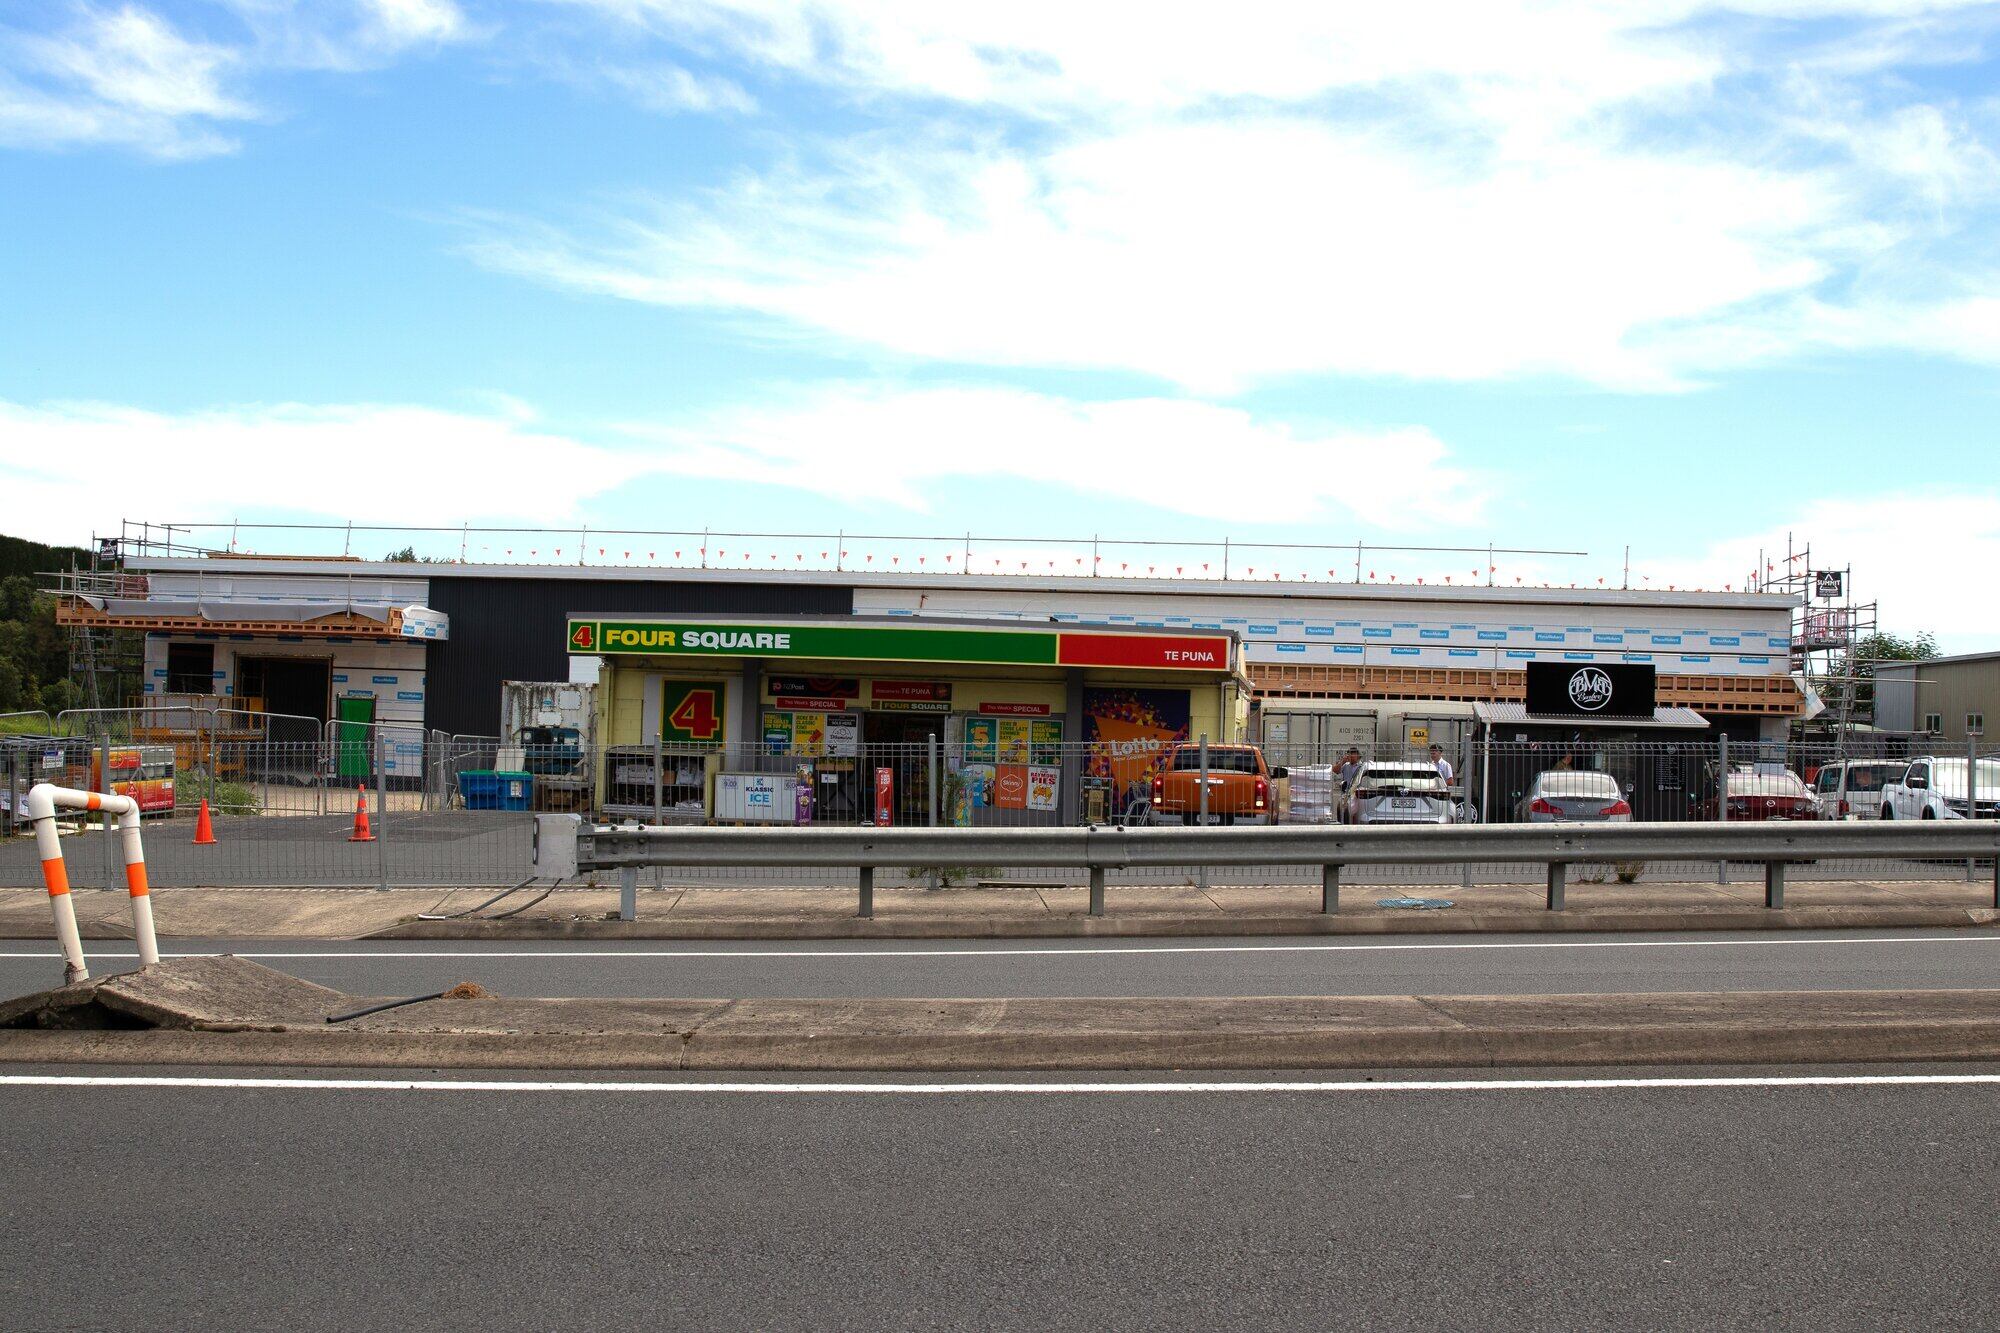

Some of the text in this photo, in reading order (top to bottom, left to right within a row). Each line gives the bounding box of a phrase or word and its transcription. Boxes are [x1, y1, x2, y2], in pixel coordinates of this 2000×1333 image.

[572, 626, 593, 647] 4
[606, 630, 790, 650] FOUR SQUARE
[1164, 650, 1214, 662] TE PUNA
[809, 700, 838, 708] SPECIAL
[669, 689, 721, 739] 4
[1111, 737, 1160, 756] Lotto
[1031, 777, 1055, 785] PIES
[750, 794, 769, 803] ICE
